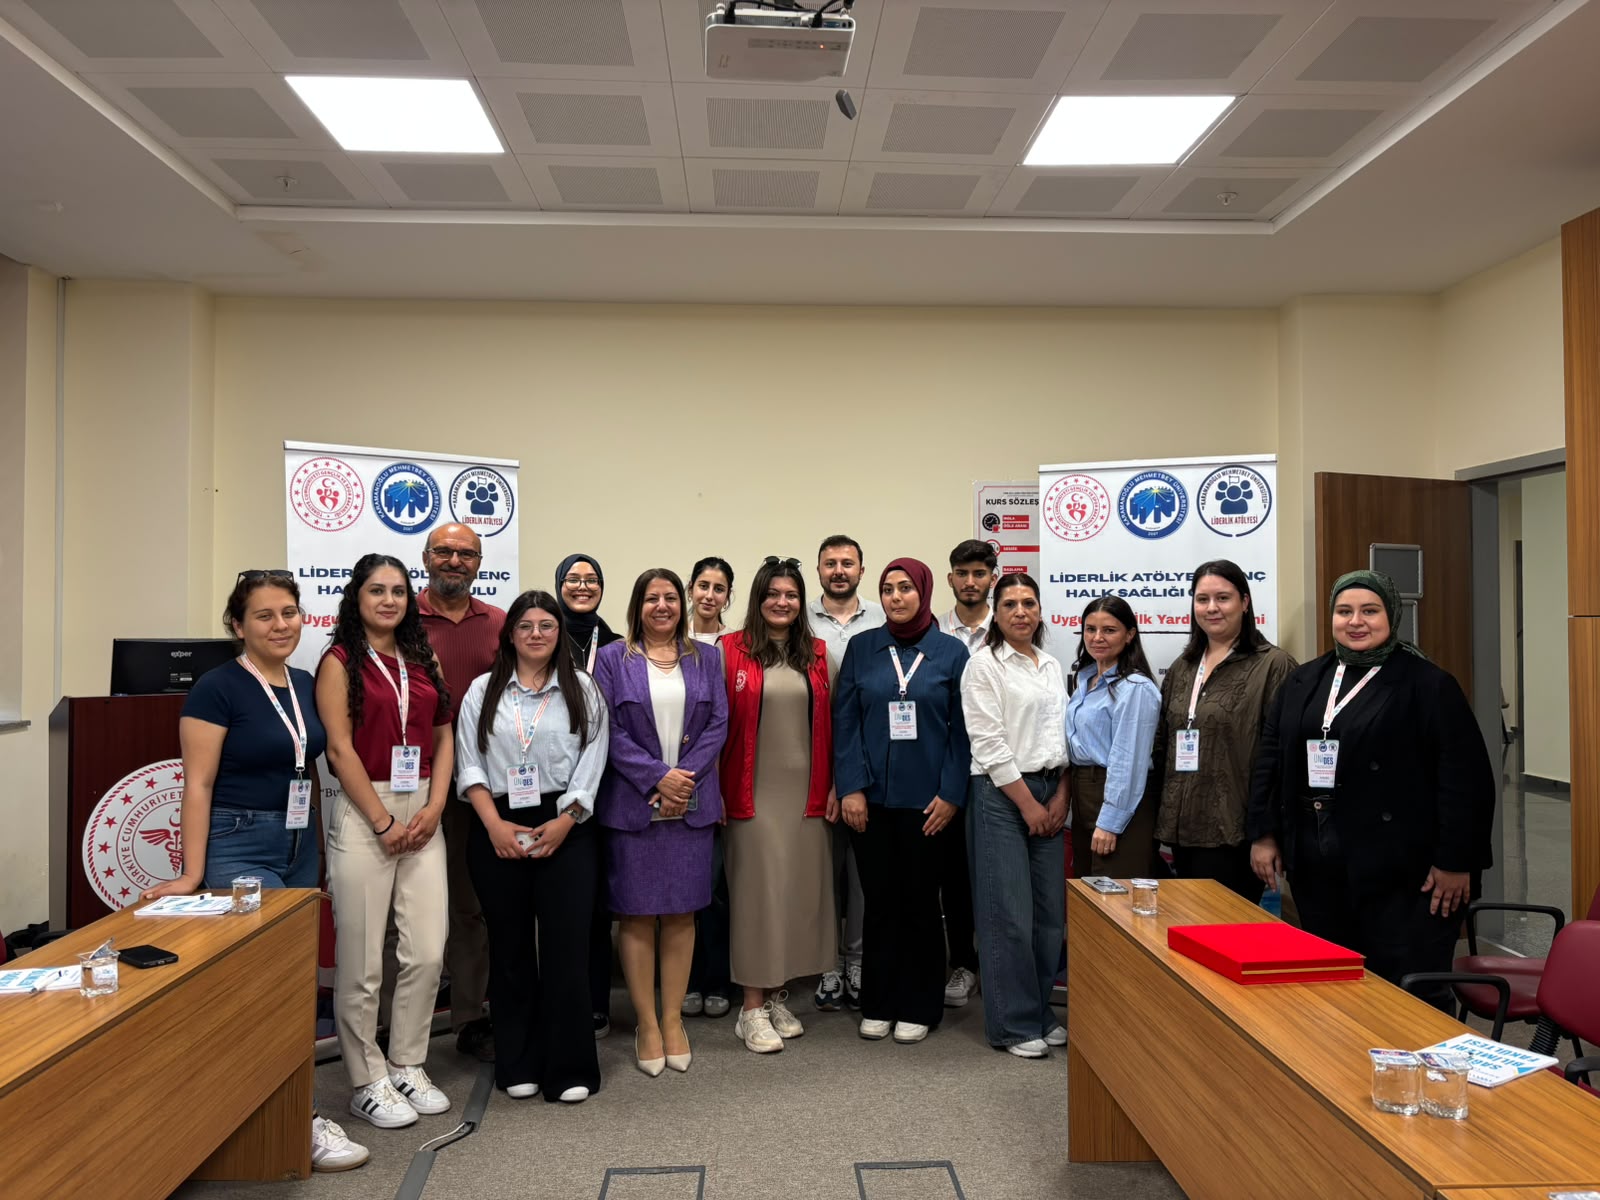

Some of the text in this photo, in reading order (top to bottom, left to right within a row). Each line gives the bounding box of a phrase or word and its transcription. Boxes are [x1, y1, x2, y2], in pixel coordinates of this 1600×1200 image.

[985, 496, 1040, 506] KURS SÖZLEŞ
[1211, 514, 1258, 525] LİDERLİK ATÖLYESİ
[299, 566, 511, 582] LİDER ENÇ
[1050, 570, 1266, 583] LİDERLİK ATÖLYE NÇ
[318, 585, 345, 595] HA
[1066, 588, 1115, 598] HALK
[1118, 586, 1185, 598] SAĞLIĞI
[1157, 614, 1191, 625] Yard
[121, 790, 183, 887] TÜRKİYE CUMHURİYET
